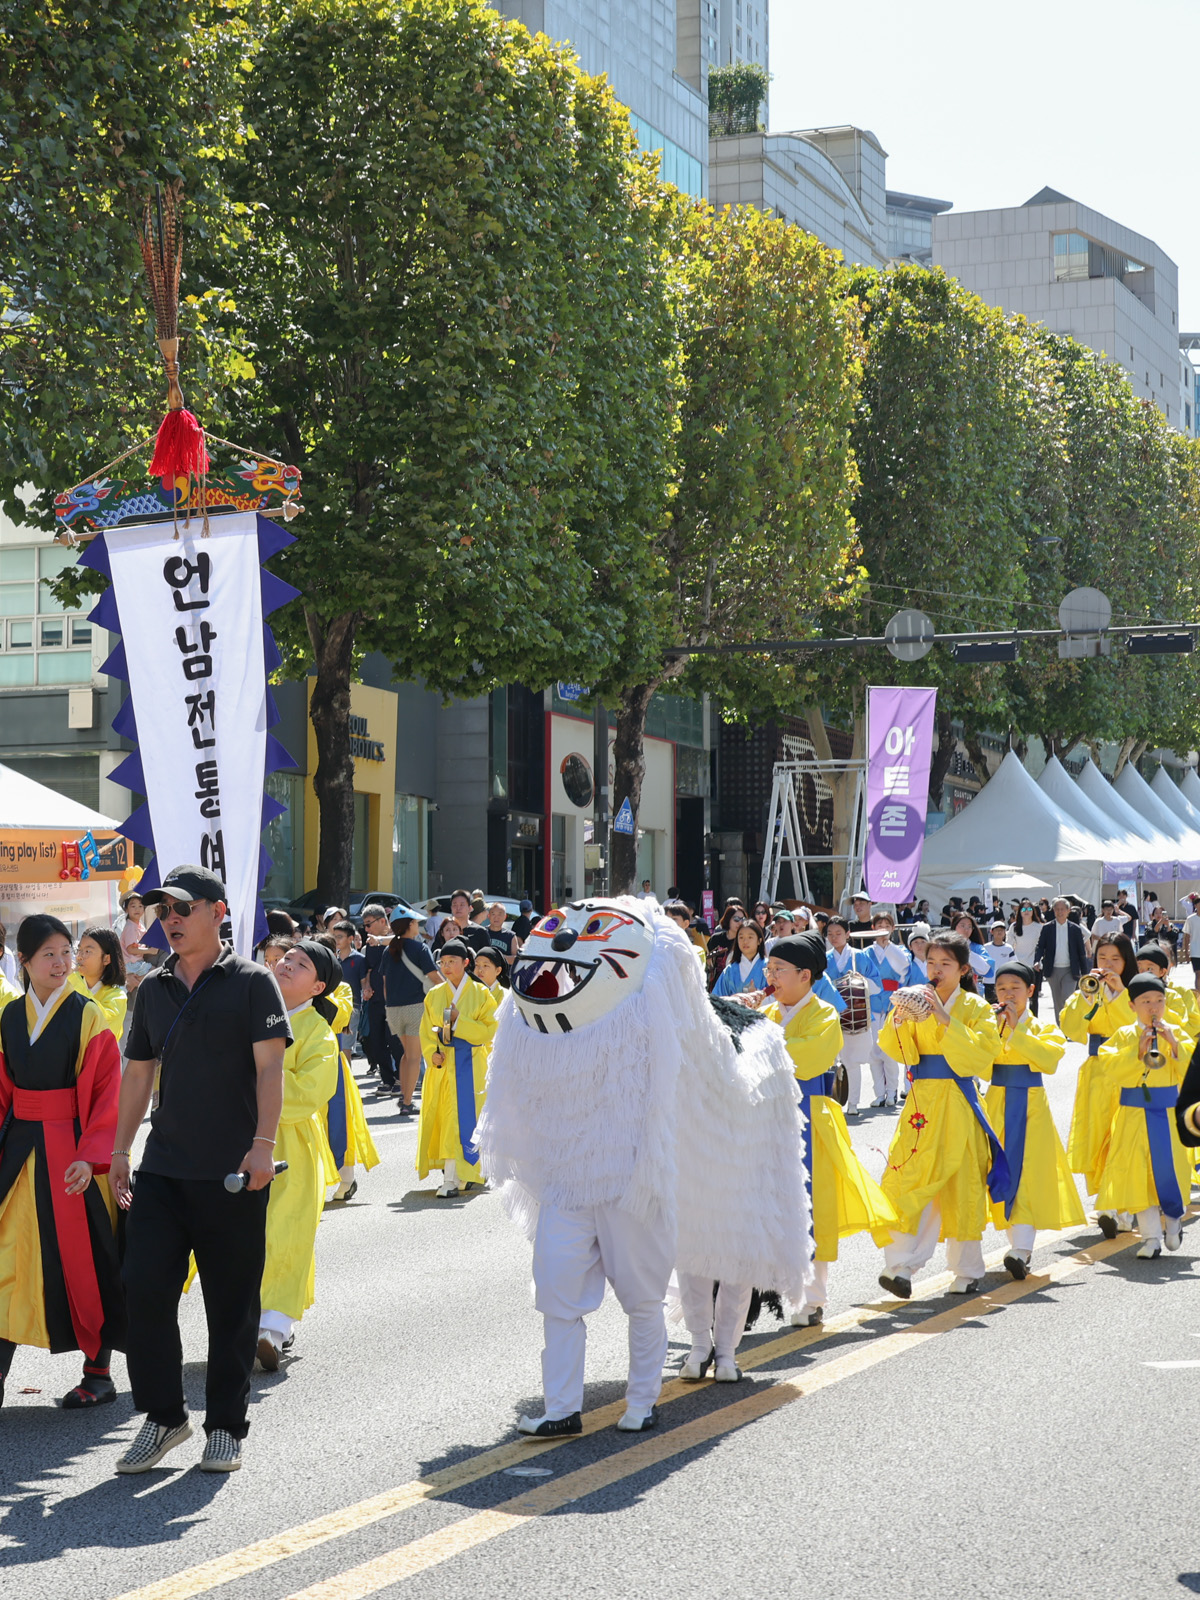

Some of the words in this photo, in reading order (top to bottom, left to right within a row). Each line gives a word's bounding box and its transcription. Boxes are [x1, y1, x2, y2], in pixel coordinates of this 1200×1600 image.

[879, 725, 916, 837] 아트존
[17, 843, 38, 861] play
[39, 841, 57, 859] list)
[115, 842, 126, 865] 12
[880, 879, 901, 888] Zone
[883, 870, 898, 879] Art
